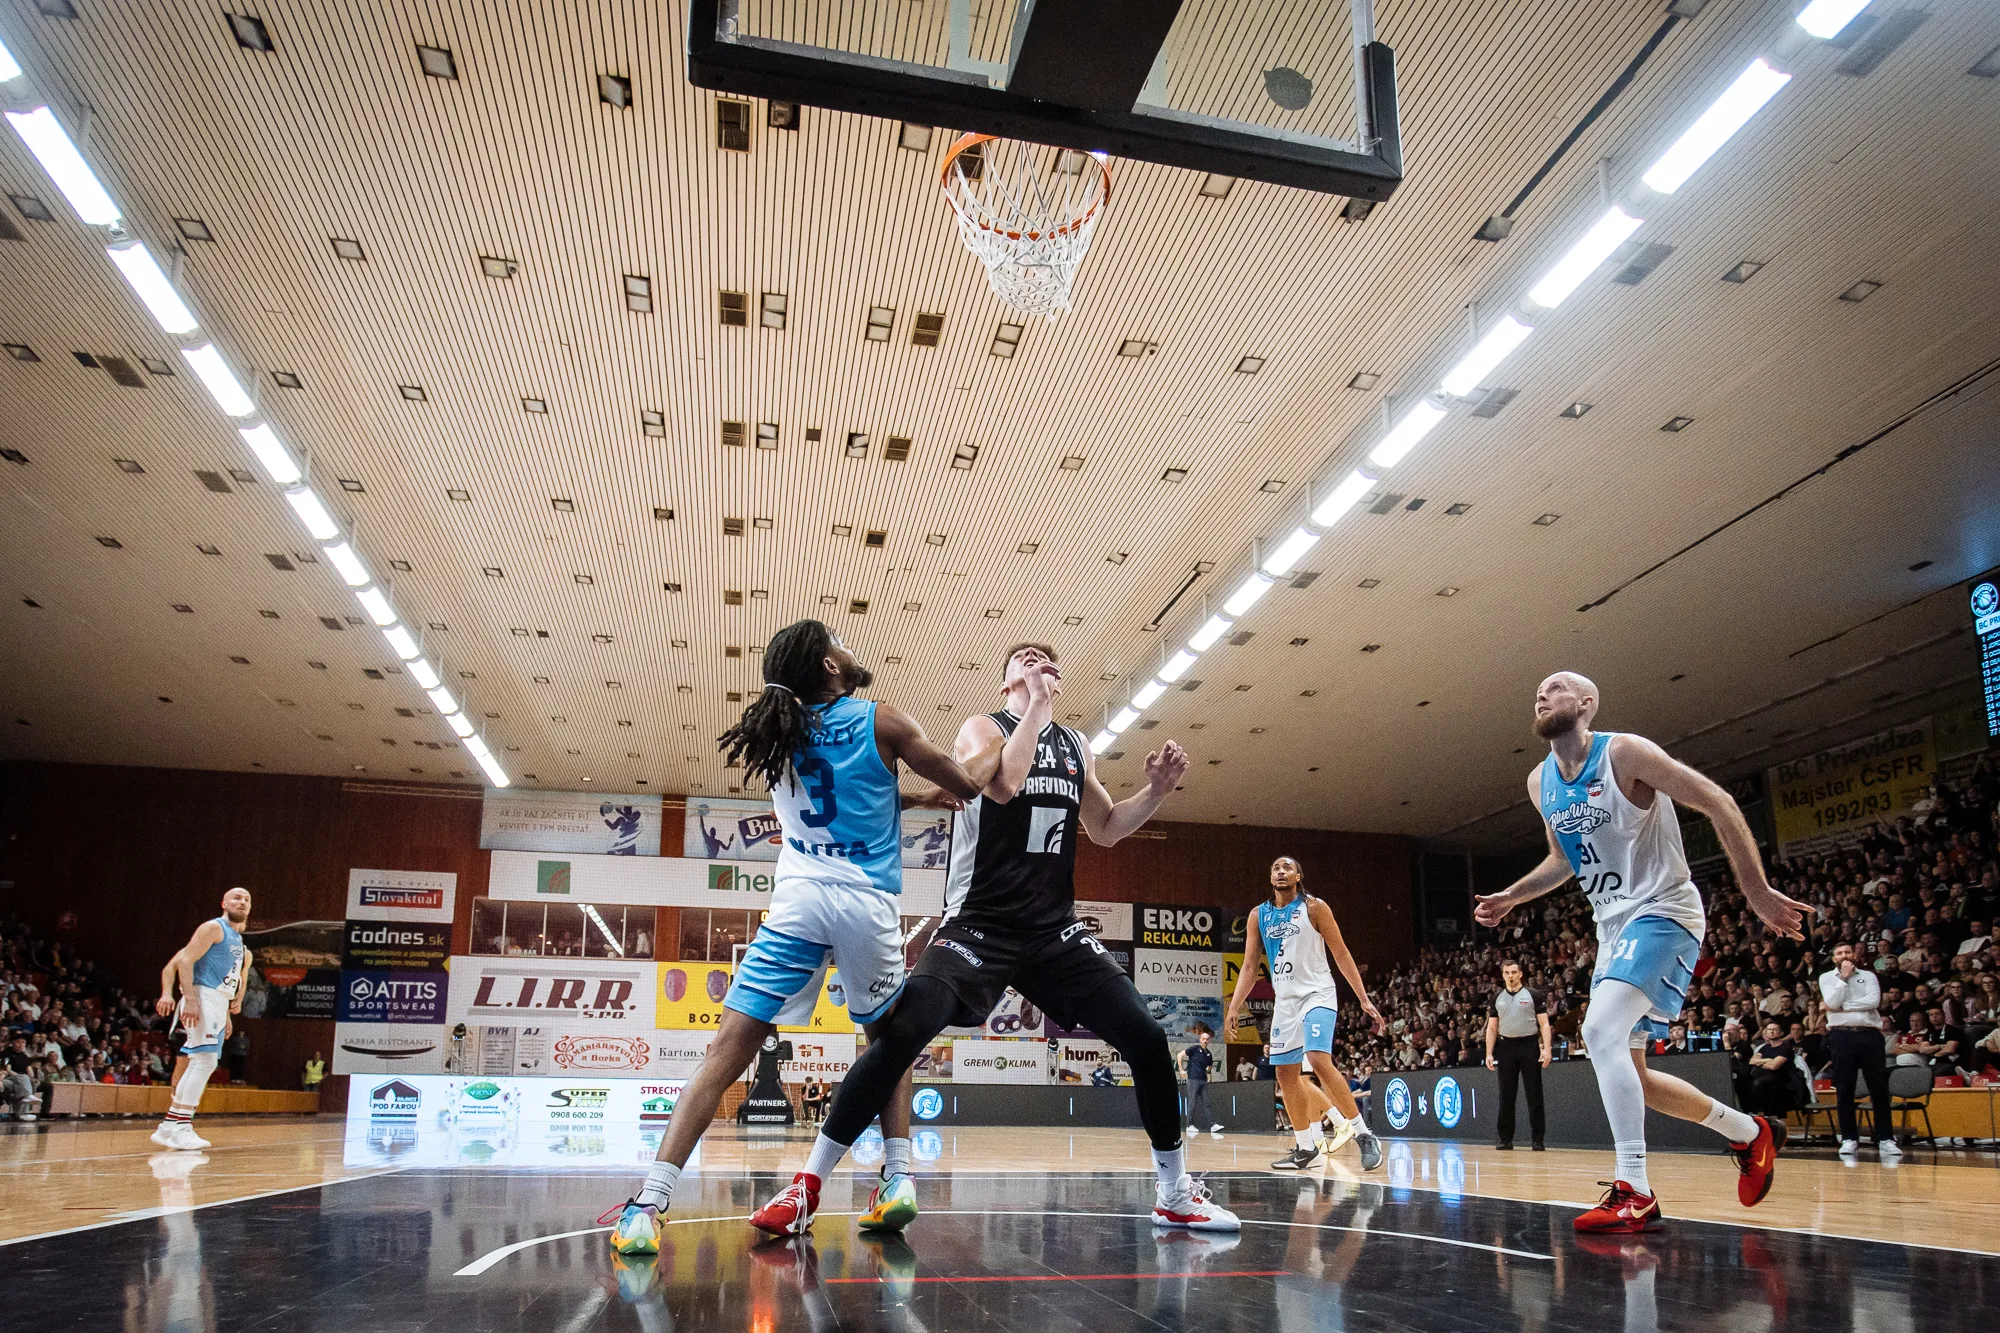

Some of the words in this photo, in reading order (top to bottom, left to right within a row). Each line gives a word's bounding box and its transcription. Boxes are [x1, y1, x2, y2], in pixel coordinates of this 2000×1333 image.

[1037, 742, 1057, 769] 24
[1814, 727, 1925, 774] Prievidza
[797, 757, 838, 829] 3
[1780, 777, 1855, 811] Majster
[1548, 807, 1570, 832] Blue
[1569, 801, 1612, 827] Wings
[1575, 841, 1601, 866] 31
[365, 888, 437, 905] Slovaktual
[1143, 908, 1213, 933] ERKO
[1143, 932, 1213, 947] REKLAMA
[1612, 939, 1638, 960] 31
[1140, 962, 1218, 977] ADVANCE
[374, 981, 437, 999] ATTIS
[1167, 977, 1218, 985] INVESTMENTS
[473, 976, 636, 1010] L.I.R.R.
[349, 1001, 436, 1010] SPORTSWEAR
[487, 1027, 509, 1035] BVH
[523, 1028, 540, 1036] AJ
[1312, 1024, 1320, 1037] 5
[963, 1058, 993, 1068] GREMI
[1008, 1059, 1037, 1068] KLIMA
